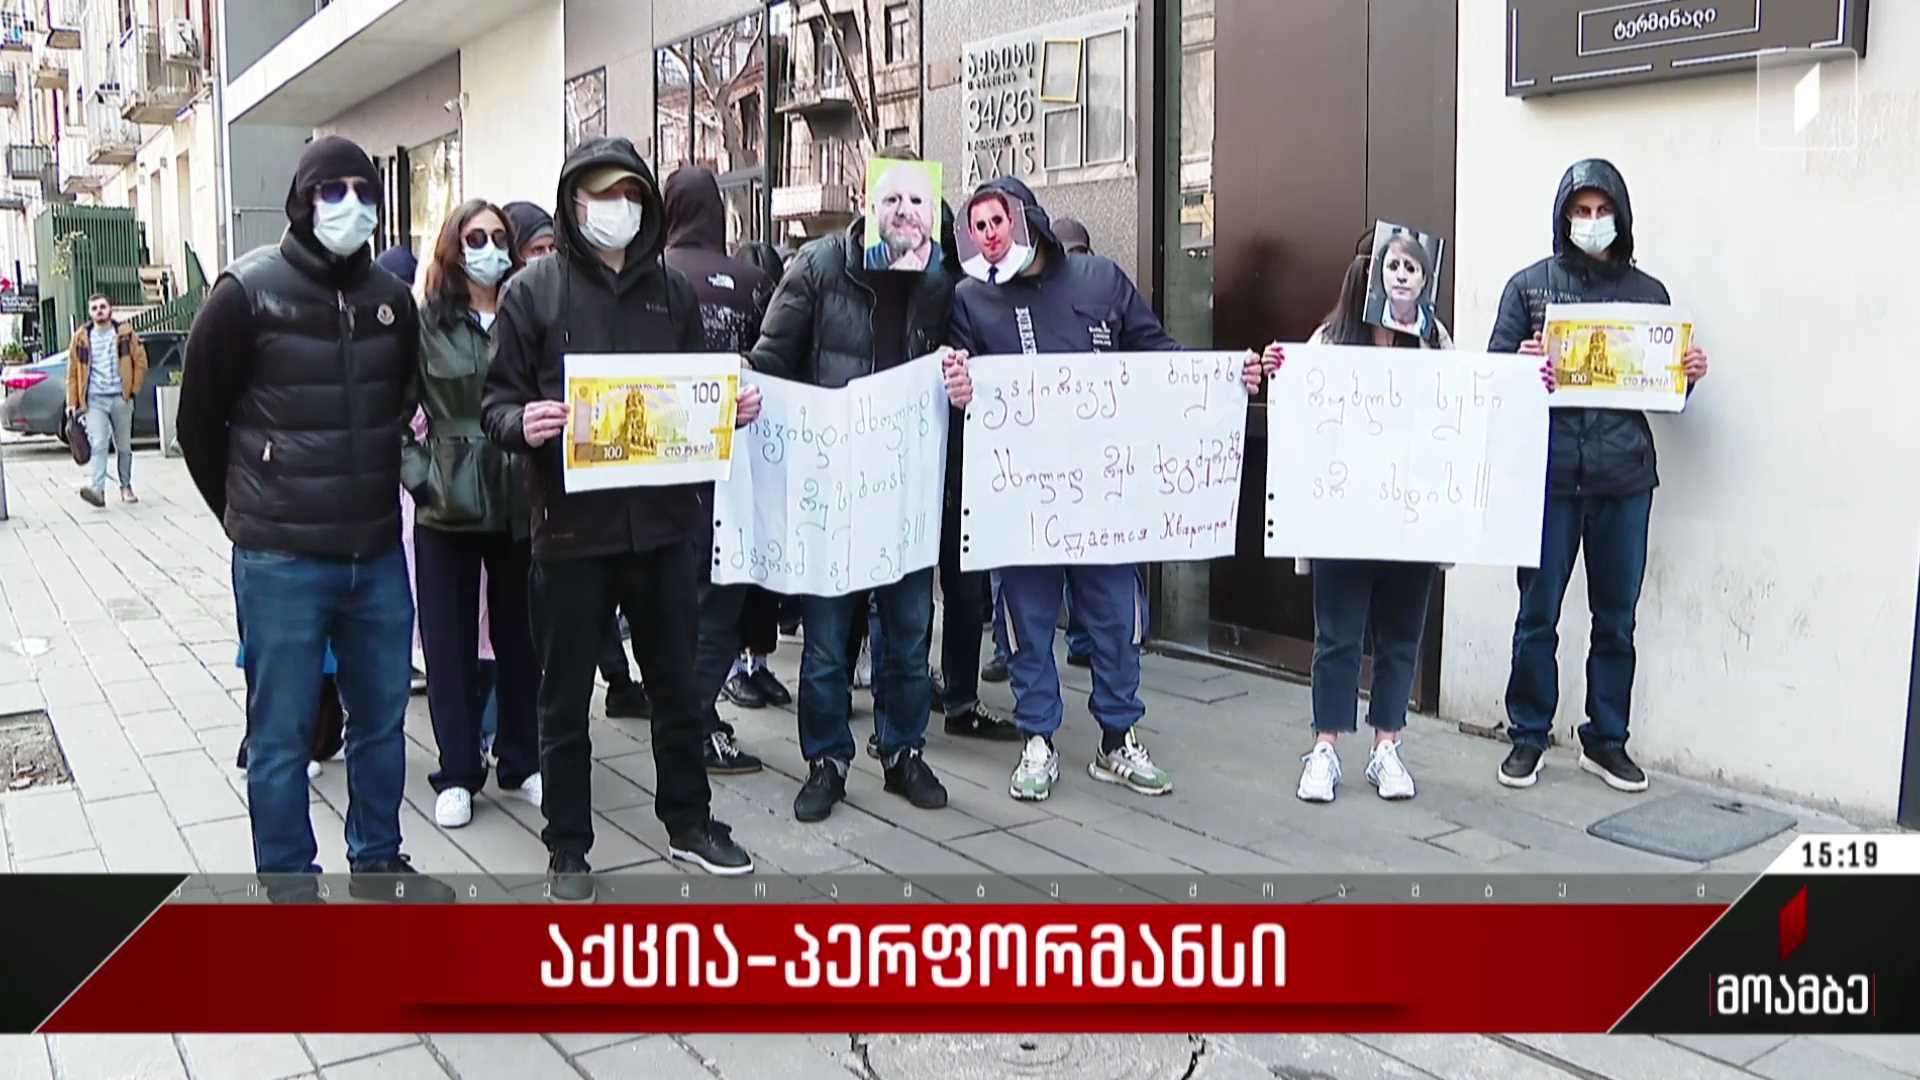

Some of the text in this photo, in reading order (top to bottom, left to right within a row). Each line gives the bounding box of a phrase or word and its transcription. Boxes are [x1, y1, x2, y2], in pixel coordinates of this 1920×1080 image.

[1613, 7, 1717, 40] ტერმინალი
[968, 89, 1034, 133] 34/36
[968, 146, 1036, 187] AXIS
[1648, 326, 1674, 344] 100
[1569, 372, 1587, 384] 100
[692, 381, 721, 404] 100
[603, 447, 623, 459] 100
